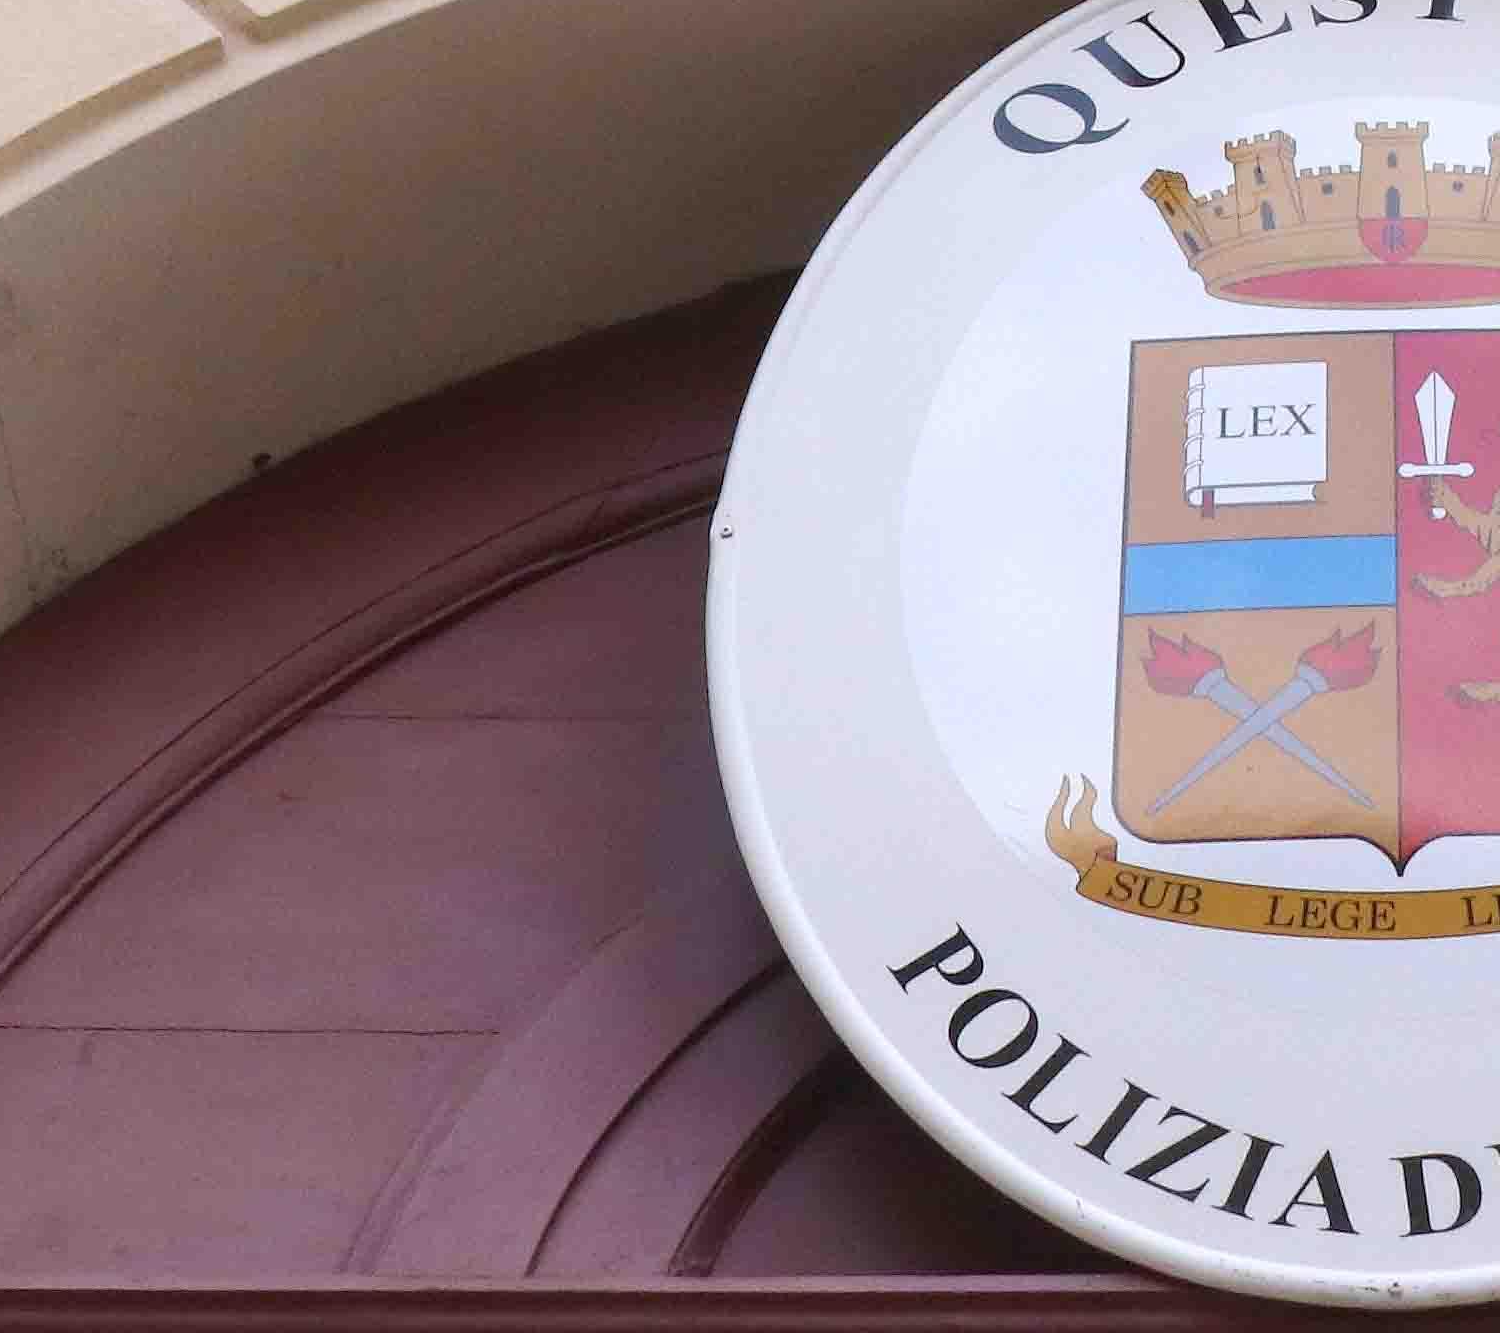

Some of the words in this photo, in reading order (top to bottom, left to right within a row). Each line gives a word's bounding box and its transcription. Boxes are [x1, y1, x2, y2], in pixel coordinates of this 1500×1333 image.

[1217, 403, 1317, 440] LEX
[1105, 870, 1202, 917] SUB
[1263, 895, 1397, 932] LEGE
[886, 922, 1361, 1236] POLIZIA
